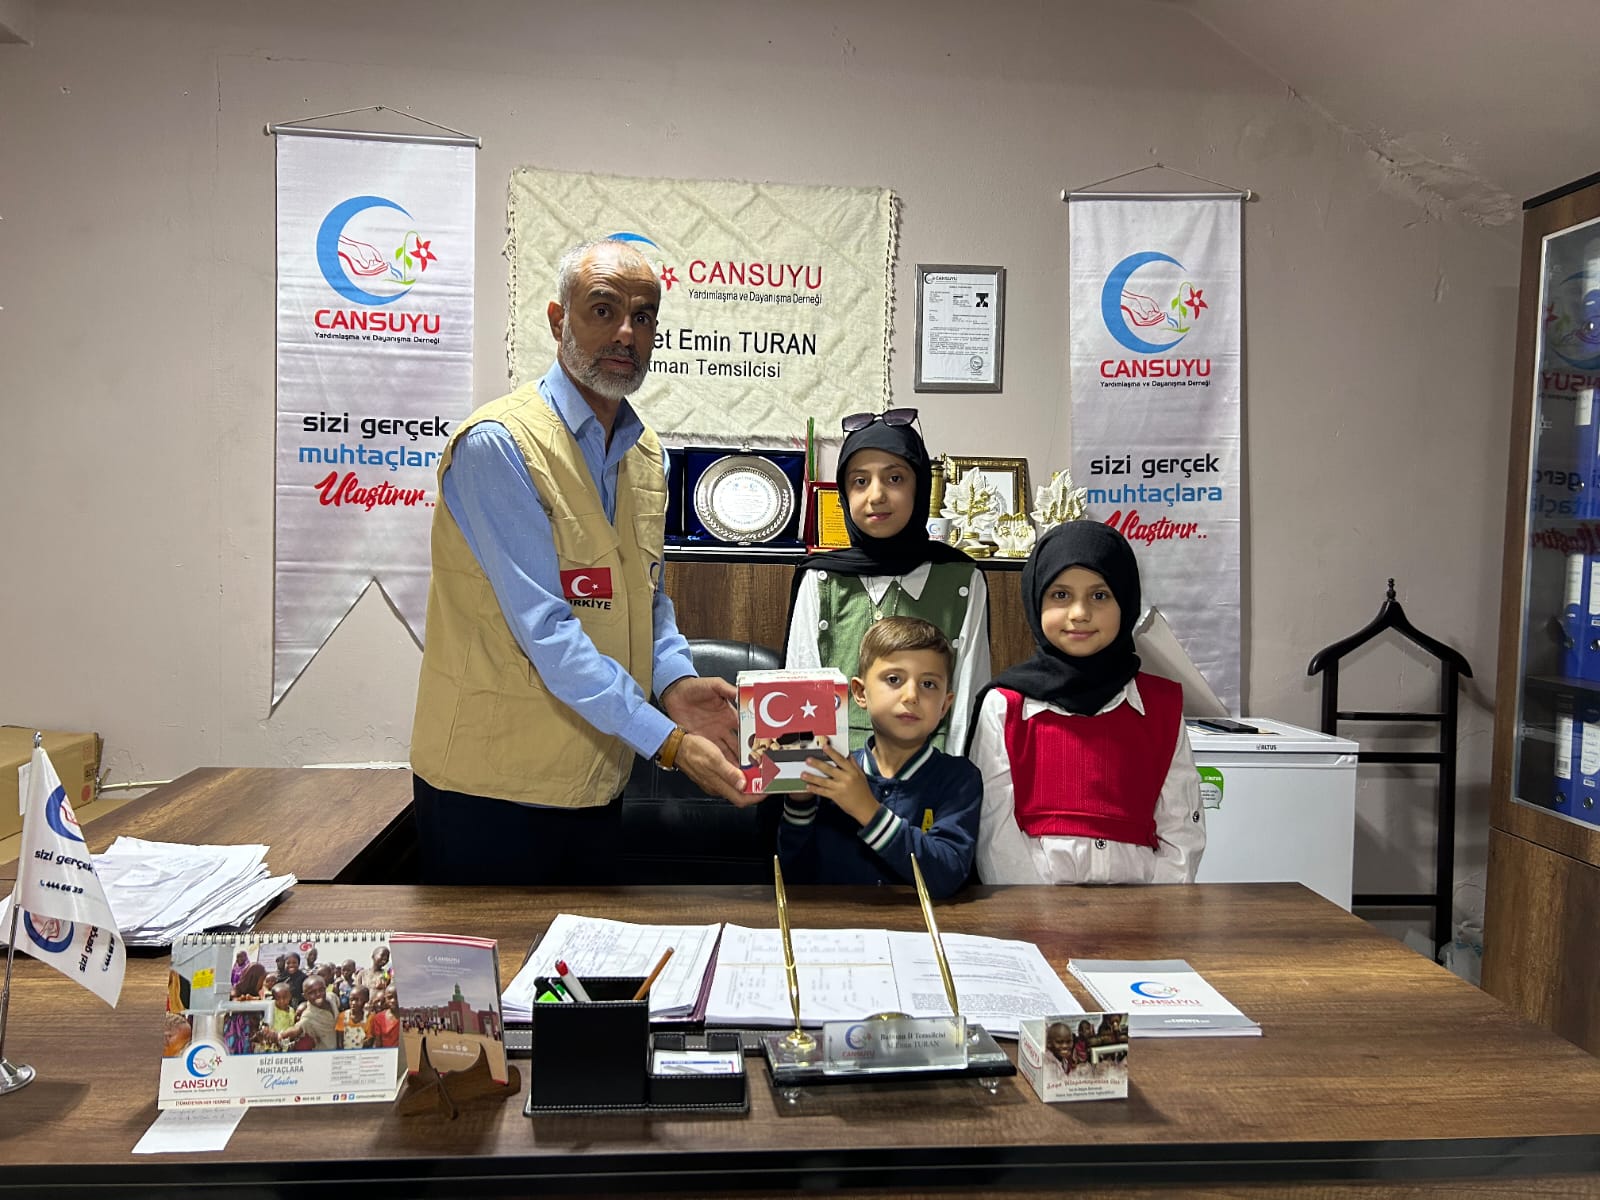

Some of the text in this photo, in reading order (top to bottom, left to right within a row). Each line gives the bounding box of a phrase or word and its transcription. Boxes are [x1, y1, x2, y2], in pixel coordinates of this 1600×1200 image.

[688, 260, 822, 290] CANSUYU
[688, 289, 822, 306] Yardımlaşma ve Dayanışma Derneği
[314, 309, 440, 334] CANSUYU
[314, 332, 360, 342] Yardımlaşma
[372, 335, 411, 343] Dayanışma
[413, 336, 440, 344] Derneği
[652, 328, 817, 356] et Emin TURAN
[695, 359, 781, 378] Temsilcisi
[1100, 359, 1211, 378] CANSUYU
[1152, 380, 1186, 388] Dayanışma
[303, 411, 450, 441] sizi gerçek
[1090, 453, 1220, 479] sizi gerçek
[1087, 483, 1223, 507] muhtaçlara
[34, 849, 54, 861] sizi
[56, 854, 94, 873] gerçek
[45, 881, 60, 890] 444
[72, 886, 84, 894] 39
[79, 925, 99, 973] sizi gerçe
[256, 1065, 305, 1075] MUHTAÇLARA
[173, 1079, 228, 1090] CANSUYU
